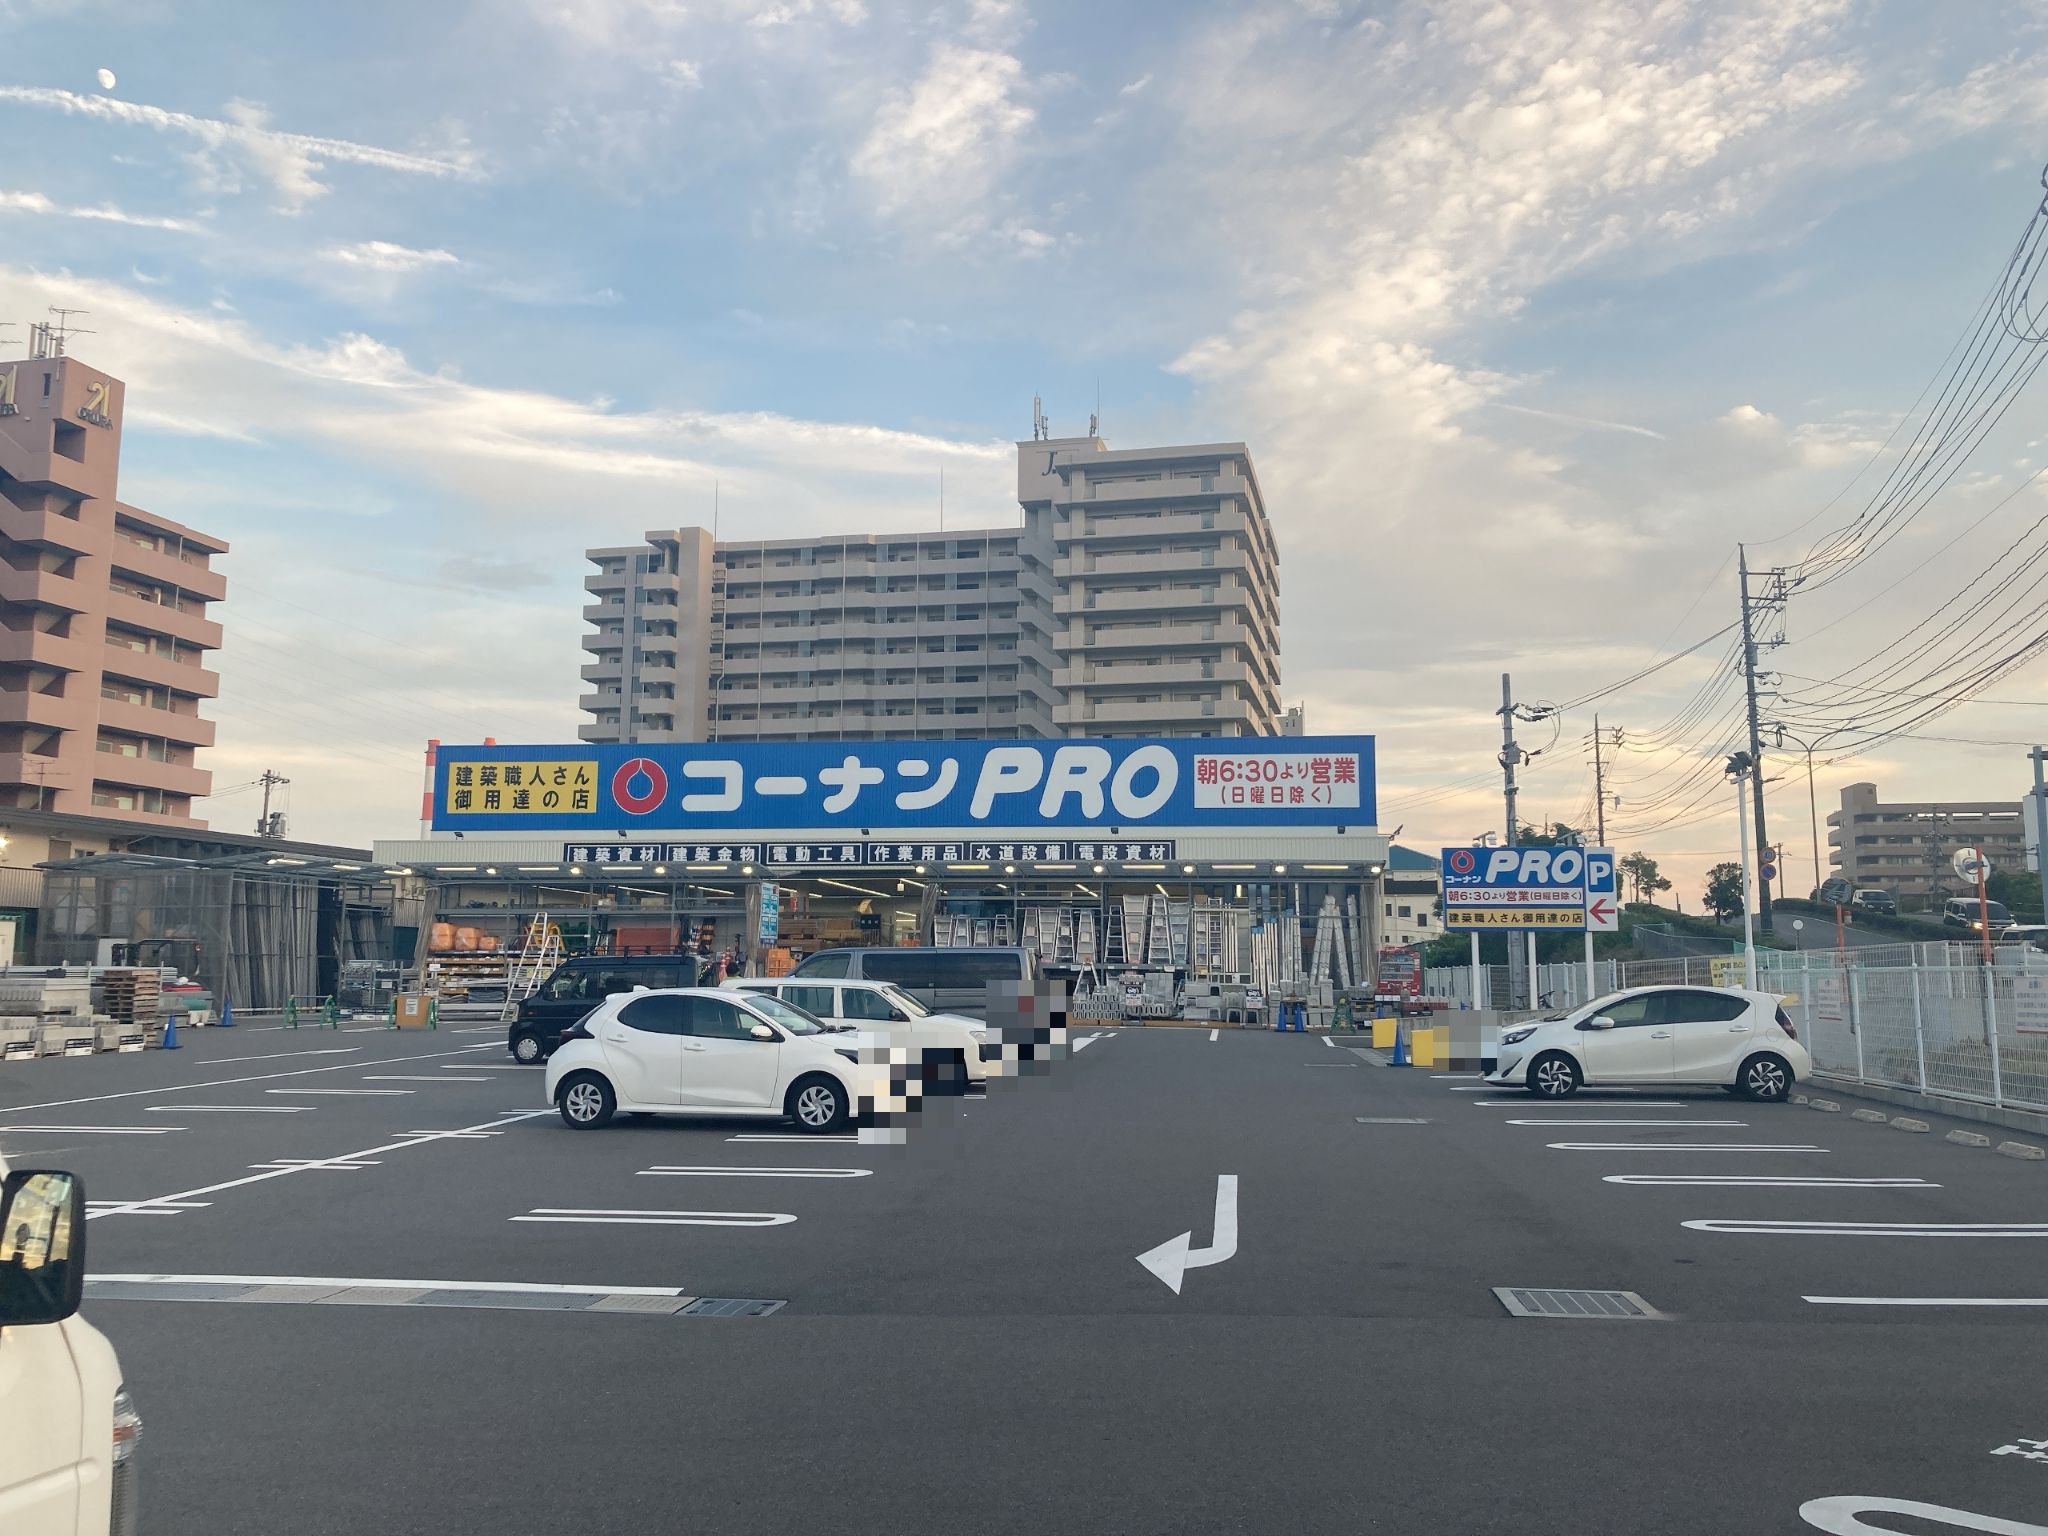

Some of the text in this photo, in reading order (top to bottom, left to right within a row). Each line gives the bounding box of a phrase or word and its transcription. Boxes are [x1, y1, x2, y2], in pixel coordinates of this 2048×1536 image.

[455, 765, 590, 786] 建築職人さん
[1197, 757, 1356, 784] 朝6:30より営業
[682, 745, 1179, 819] コーナン PRO
[454, 789, 590, 810] 御用達の店
[573, 847, 656, 862] 建築資材
[672, 847, 755, 862] 建築金物
[773, 846, 856, 862] 電動工具
[874, 845, 958, 861] 作業用品
[976, 845, 1061, 861] 水道設備
[1079, 845, 1166, 861] 電設資材
[1485, 850, 1583, 883] PRO
[1589, 861, 1611, 886] P
[1445, 875, 1482, 883] コーナン
[1449, 912, 1583, 924] 建築職人さん御用達の店
